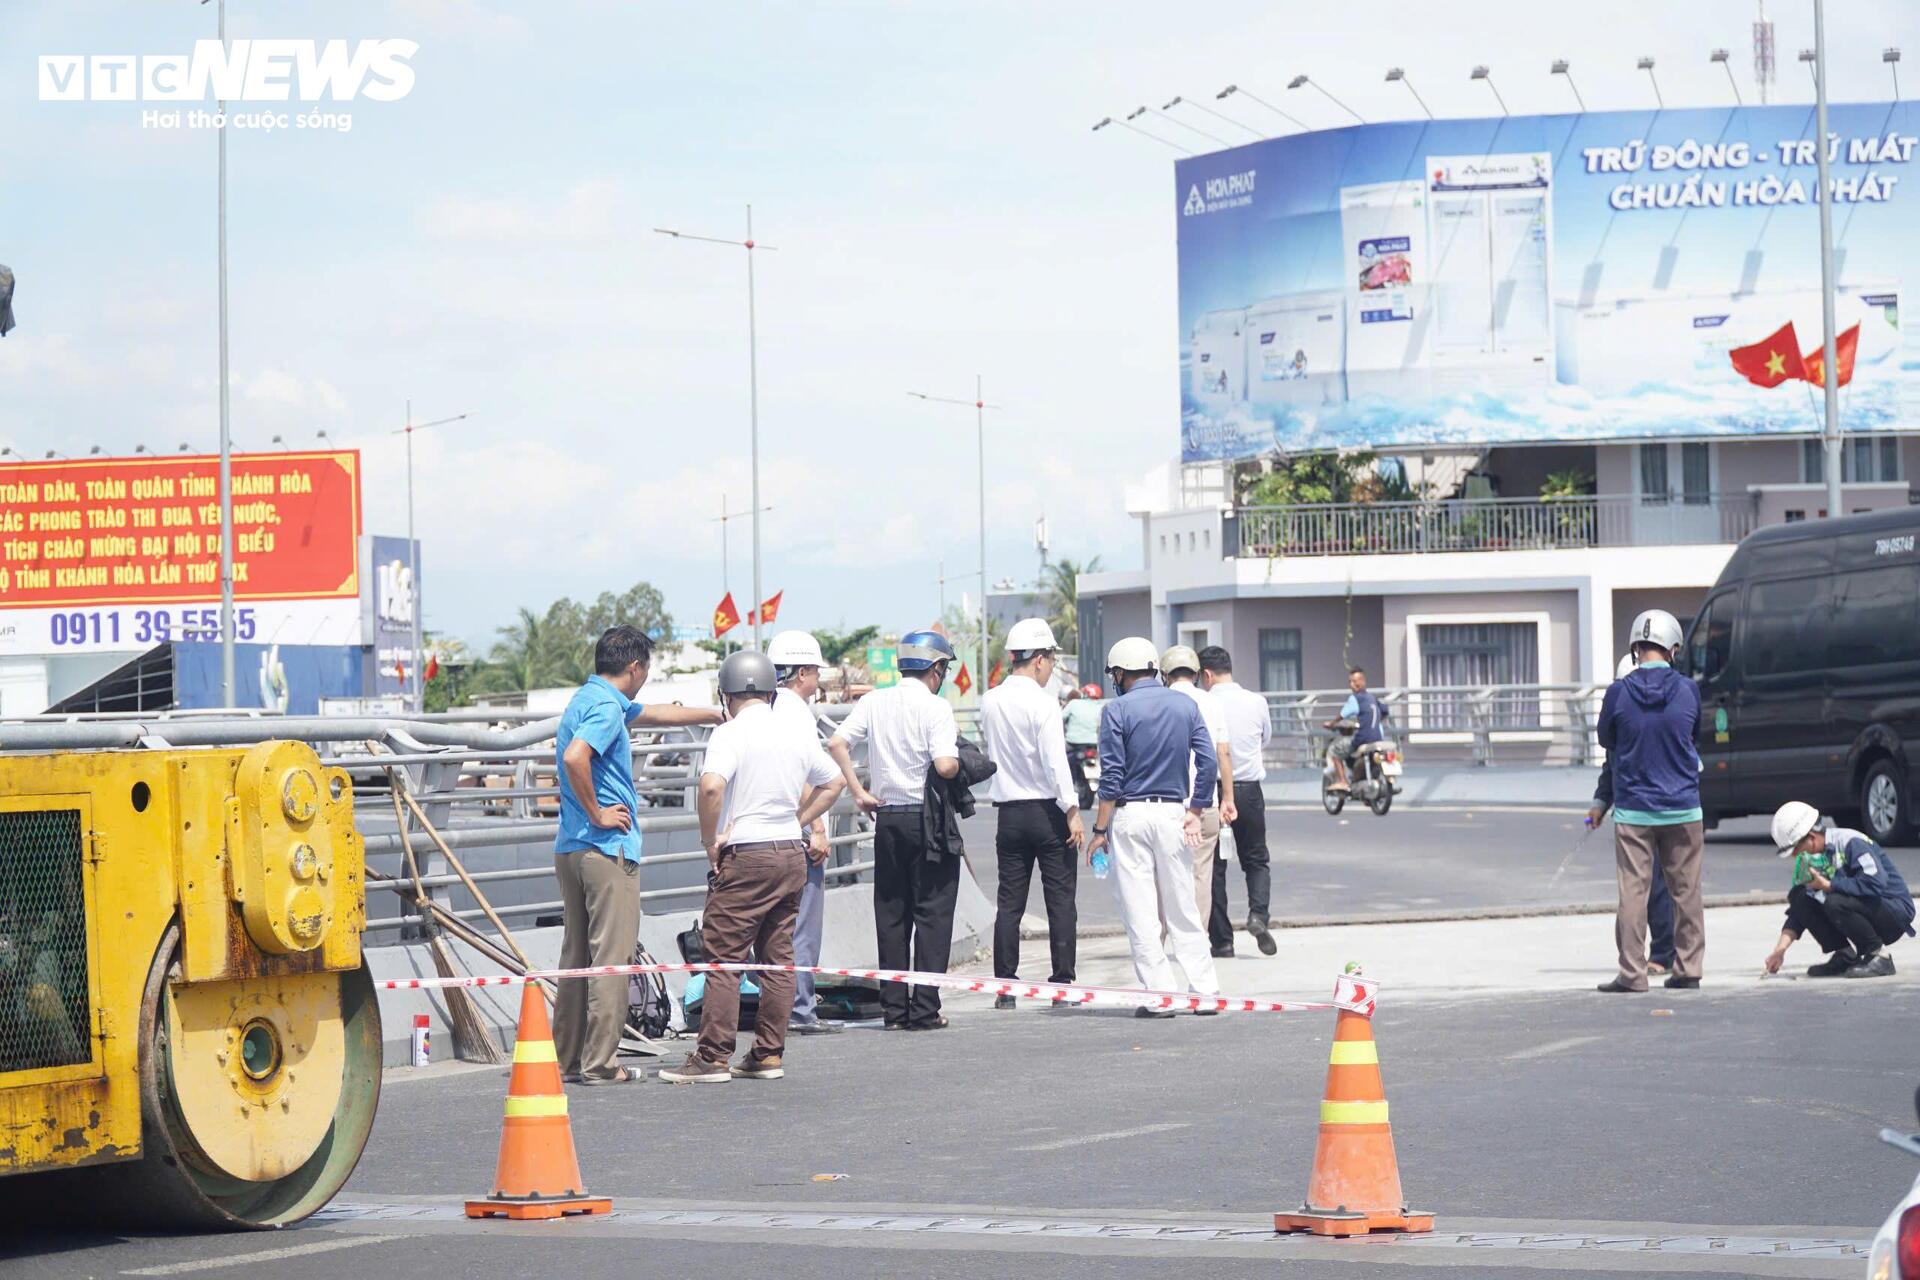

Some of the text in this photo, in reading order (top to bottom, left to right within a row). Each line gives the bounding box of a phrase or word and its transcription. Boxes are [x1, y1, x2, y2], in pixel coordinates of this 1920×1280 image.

[1584, 138, 1647, 172] TRỮ
[1652, 138, 1750, 169] ĐÔNG
[1734, 173, 1807, 205] HÒA
[0, 469, 312, 503] TOÀN DÂN, TOÀN QUÂN TỈNH HÁNH HÒA
[30, 510, 82, 531] PHONG
[87, 505, 126, 529] TRÀO
[132, 508, 156, 527] THI
[162, 506, 193, 527] ĐUA
[4, 538, 38, 561] TÍCH
[44, 536, 85, 559] CHÀO
[90, 534, 136, 558] MỪNG
[142, 536, 168, 560] ĐẠI
[174, 532, 201, 559] HỘI
[15, 564, 50, 589] TỈNH
[55, 564, 108, 588] KHÁNH
[113, 561, 145, 585] HÒA
[51, 612, 120, 646] 0911
[134, 610, 171, 643] 39
